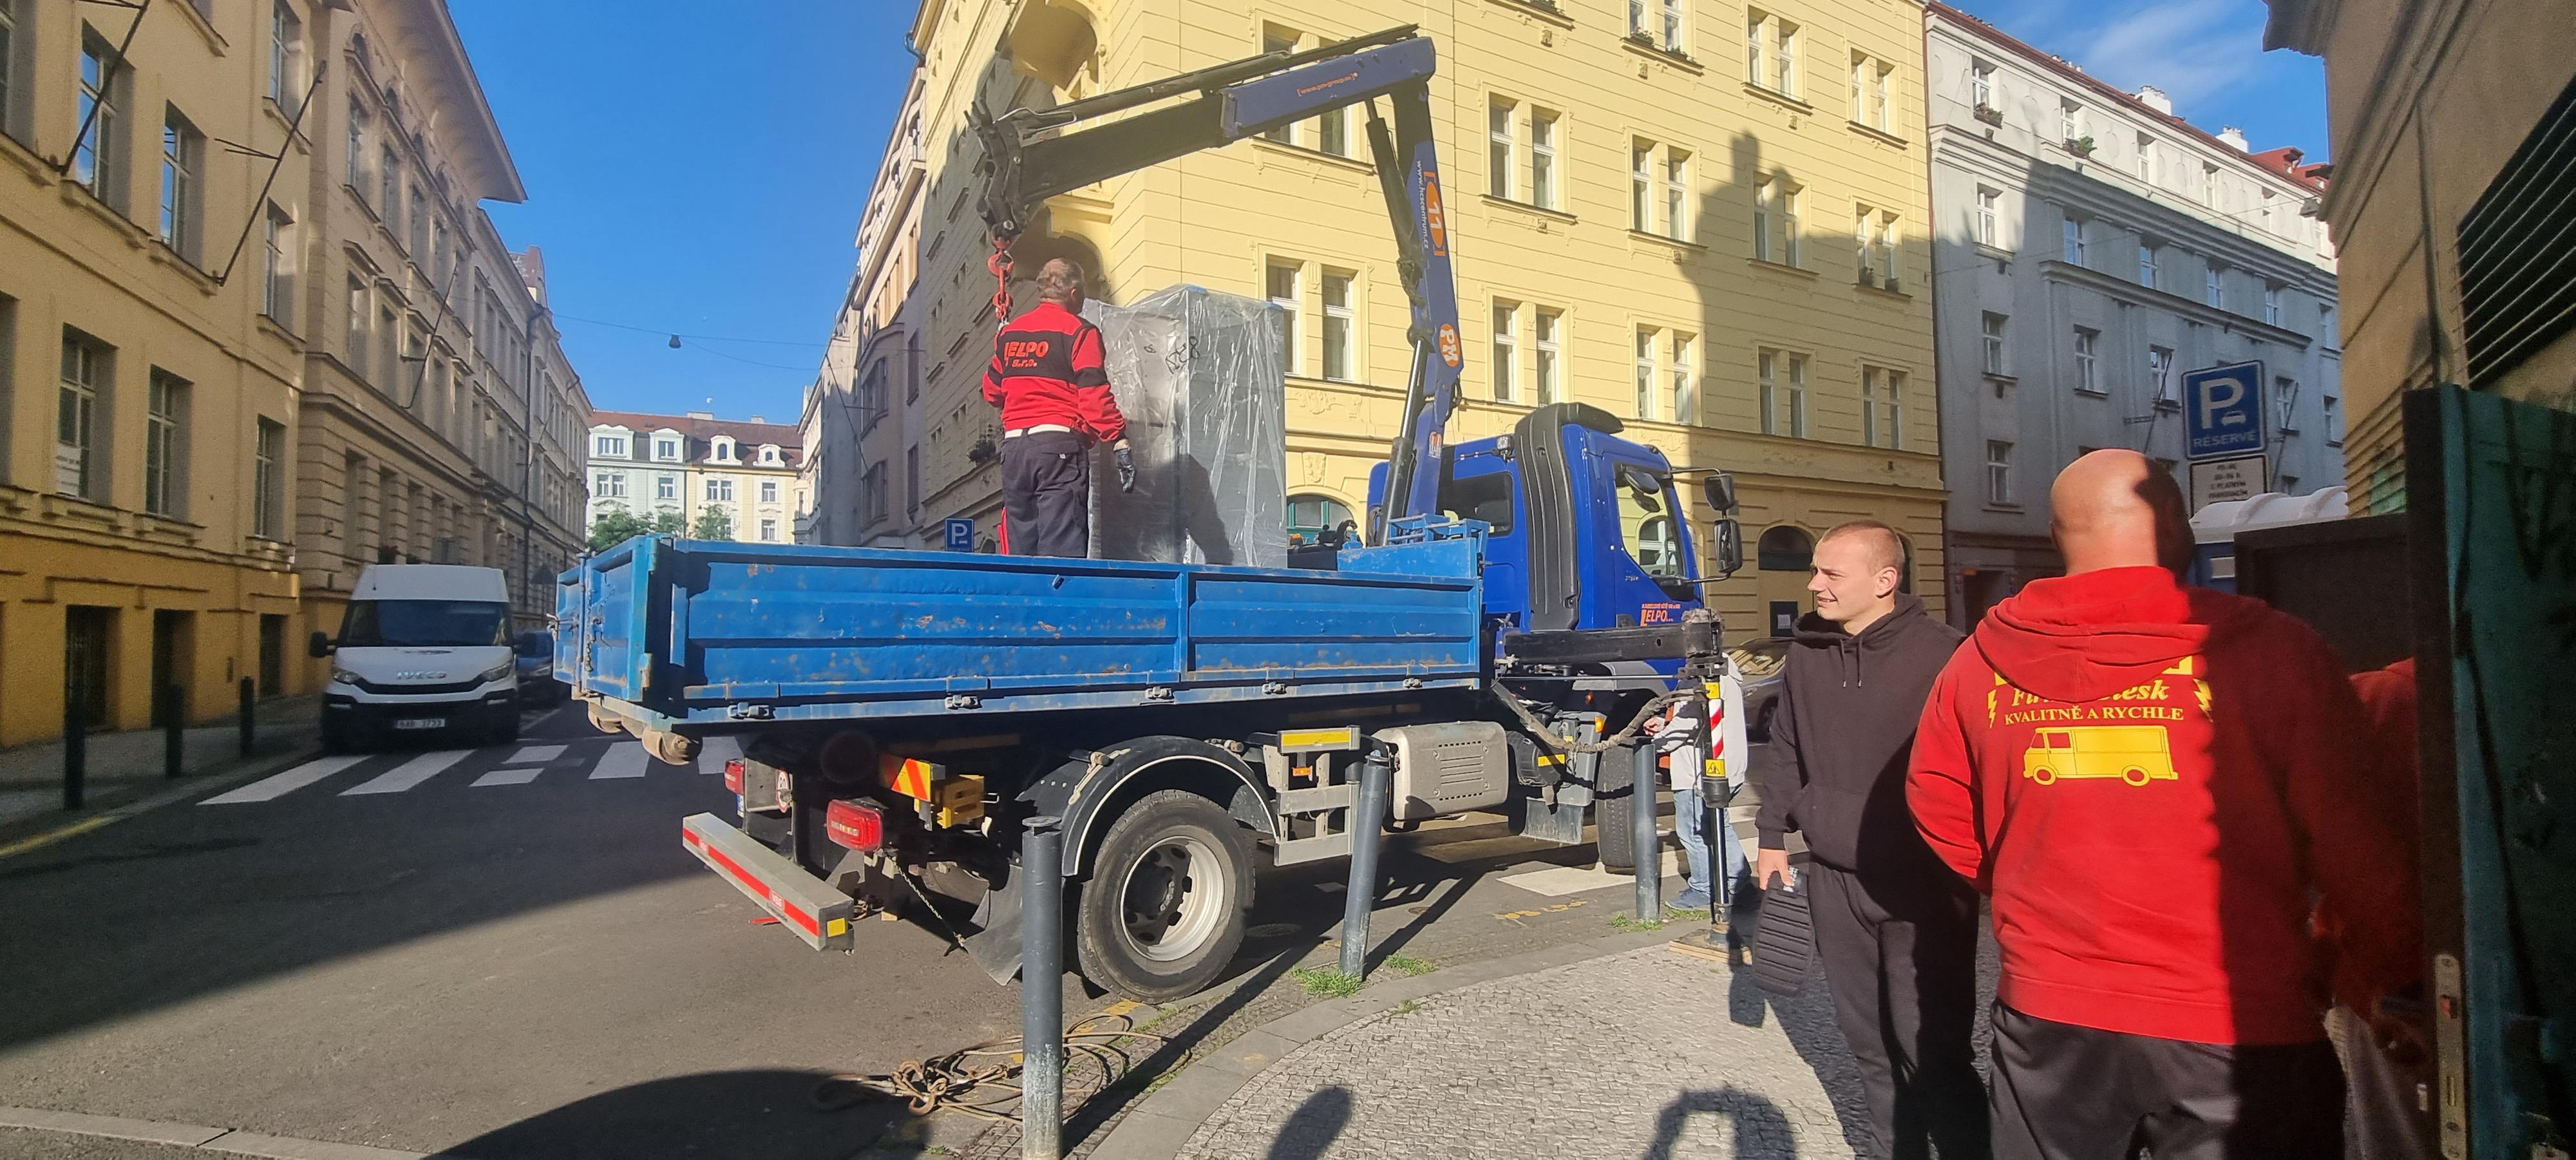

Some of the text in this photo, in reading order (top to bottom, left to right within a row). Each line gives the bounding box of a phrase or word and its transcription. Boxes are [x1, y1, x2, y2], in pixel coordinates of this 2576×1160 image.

[1428, 201, 1442, 229] 11
[1440, 329, 1459, 362] PM
[2200, 377, 2244, 430] P
[951, 523, 968, 545] P
[1640, 609, 1668, 627] LELPO
[397, 670, 447, 680] IVECO
[2004, 705, 2184, 725] KVALITNĚ A RYCHLE
